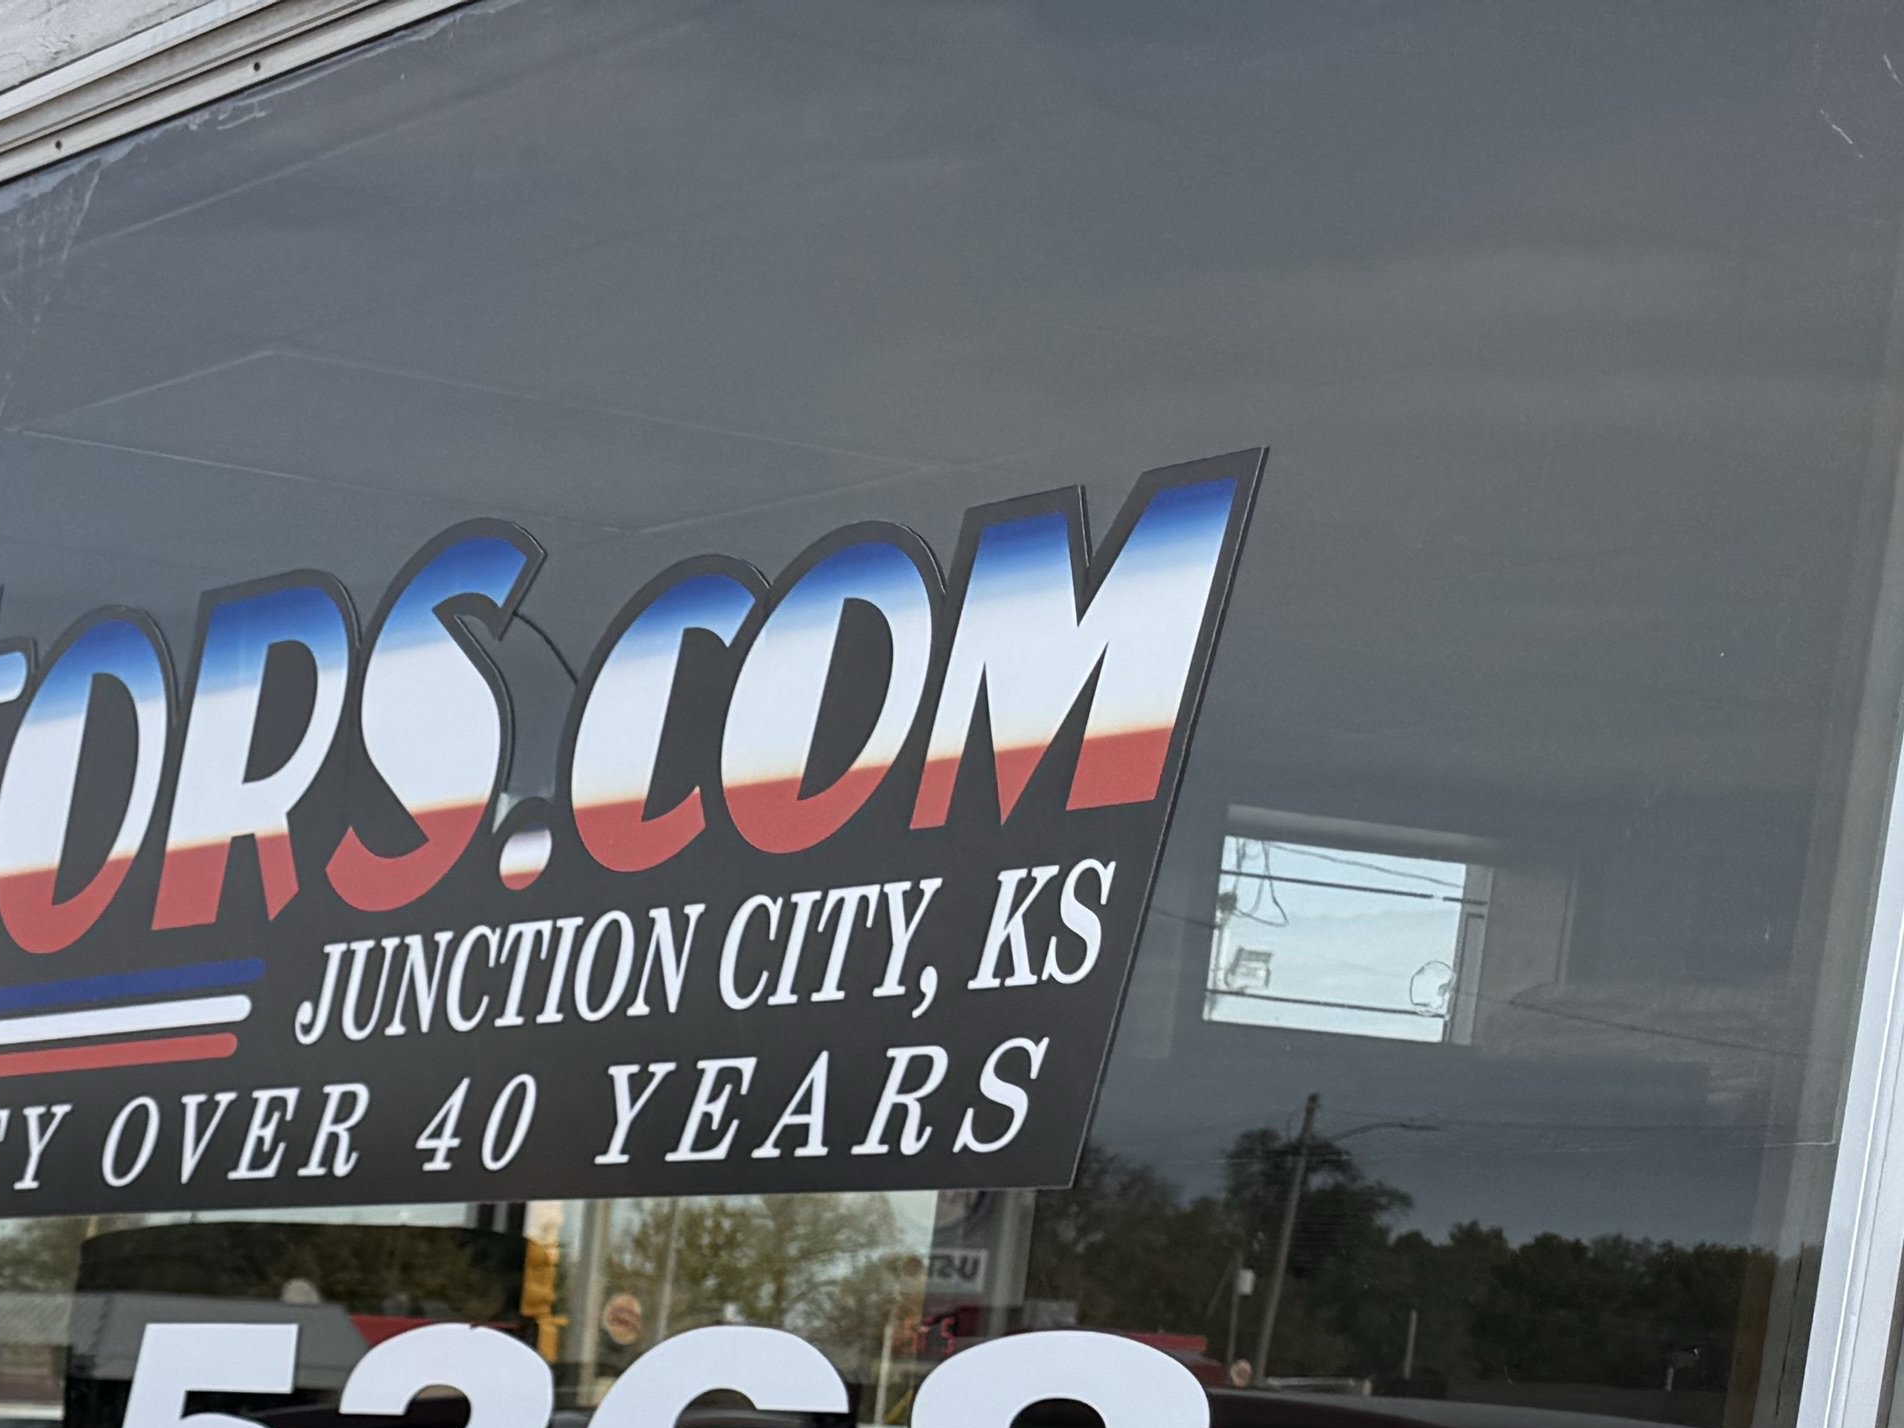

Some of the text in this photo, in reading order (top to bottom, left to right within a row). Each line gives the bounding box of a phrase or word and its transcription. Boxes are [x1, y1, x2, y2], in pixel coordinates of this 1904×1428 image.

[294, 857, 1117, 1046] JUNCTION CITY, KS
[101, 1082, 372, 1188] OVER
[414, 1073, 538, 1173] 40
[593, 1036, 1050, 1166] YEARS
